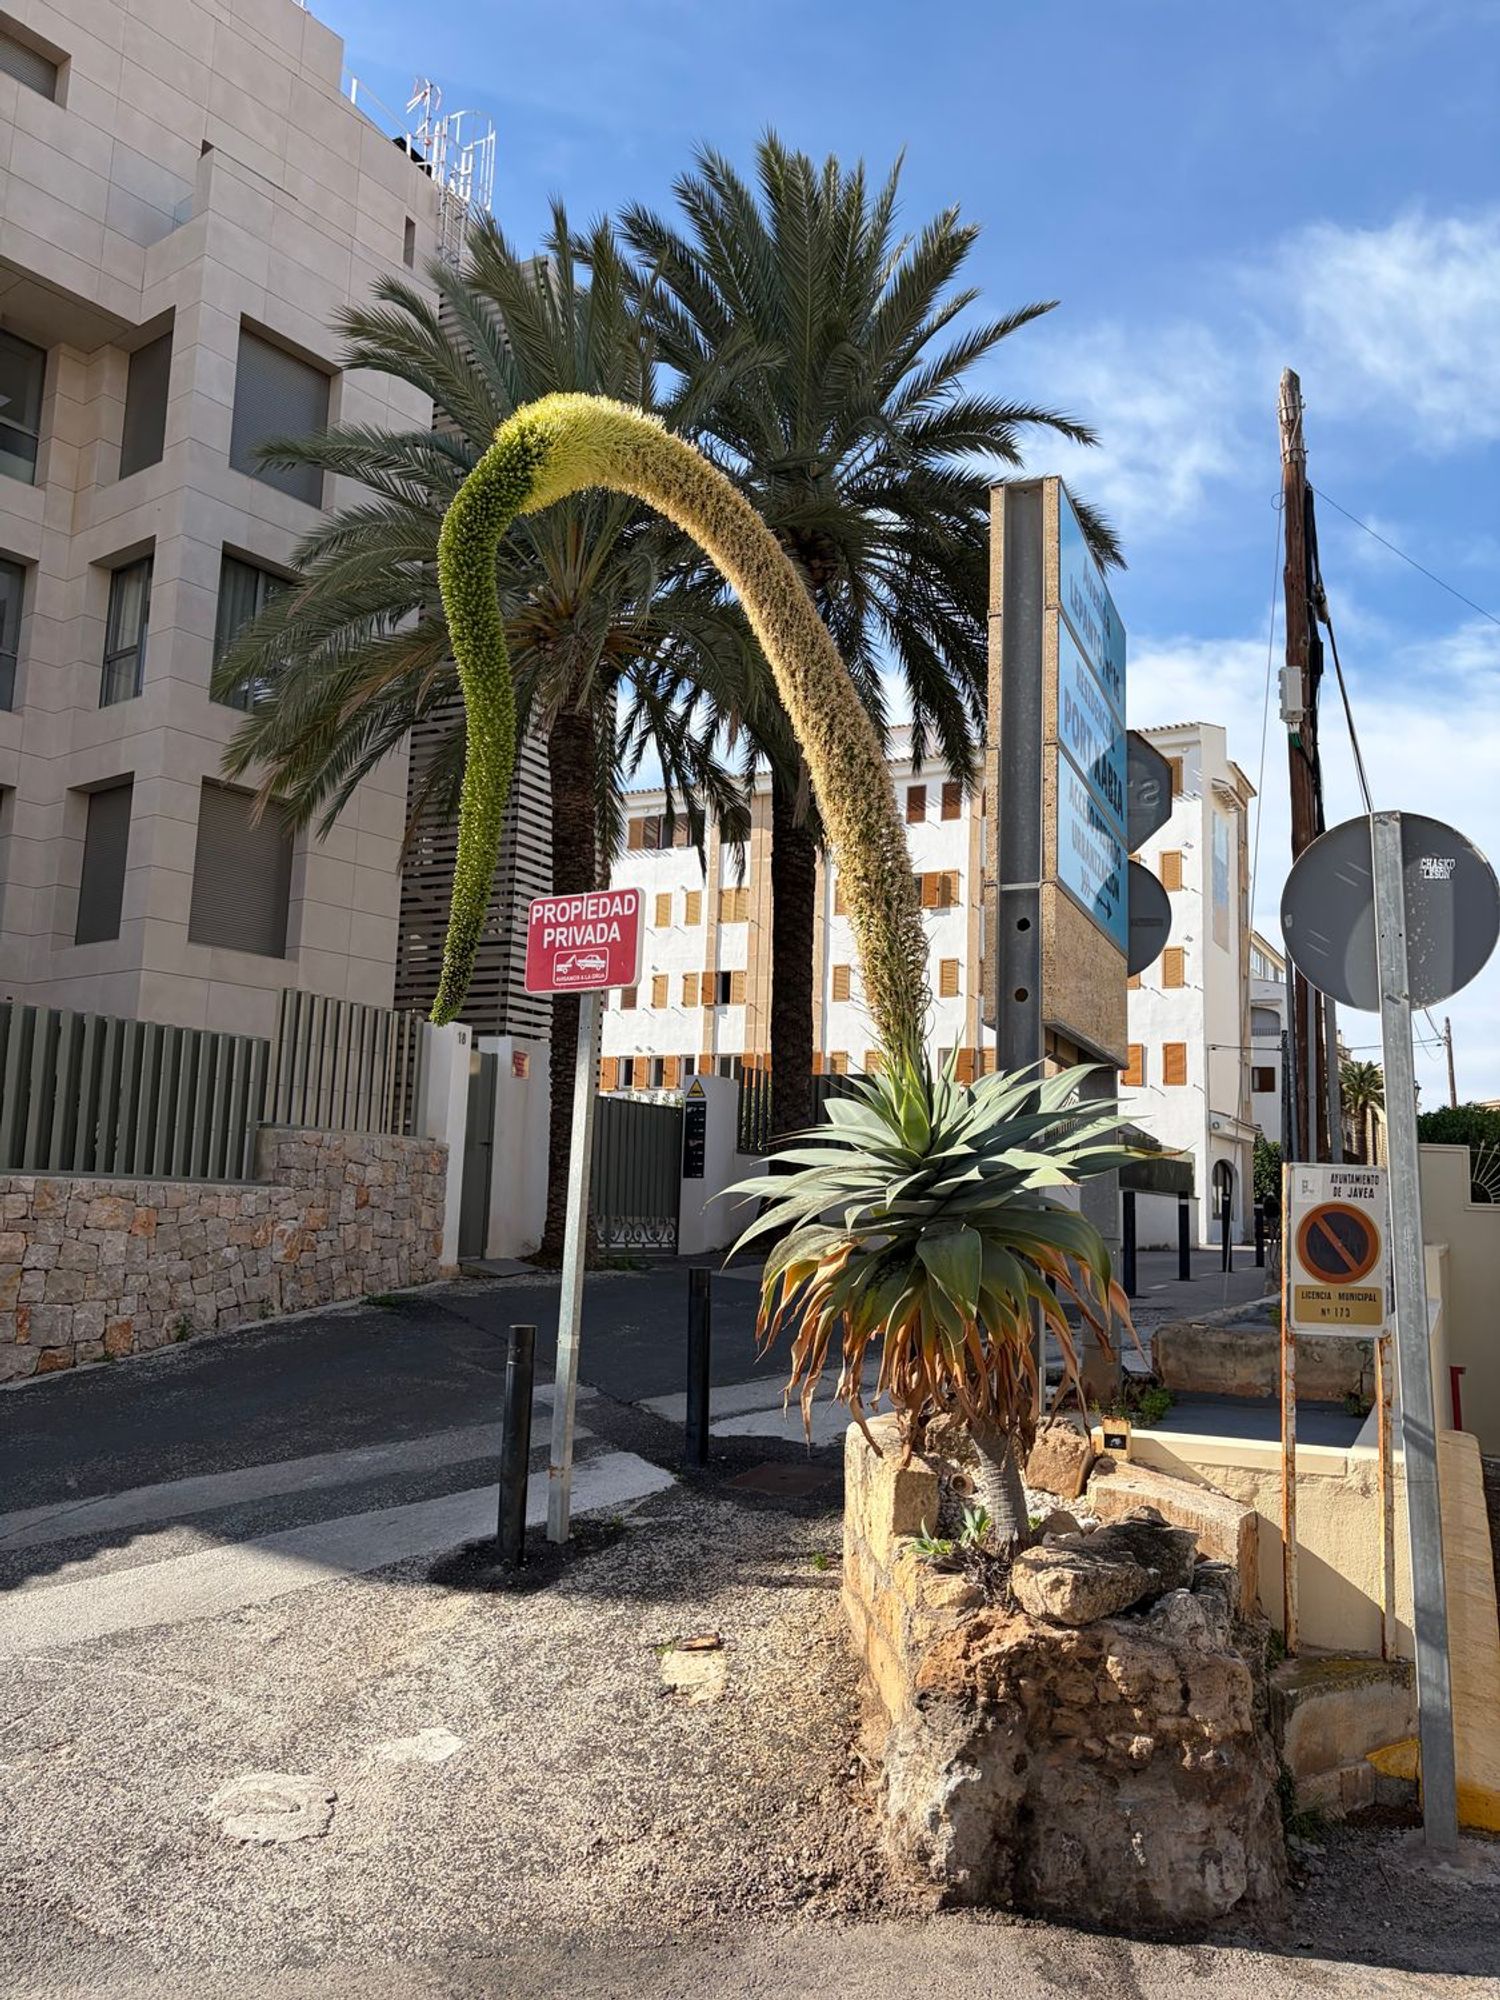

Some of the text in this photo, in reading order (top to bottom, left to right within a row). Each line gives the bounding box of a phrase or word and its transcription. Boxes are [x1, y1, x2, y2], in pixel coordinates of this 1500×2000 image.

[1064, 686, 1092, 768] PORT
[532, 894, 636, 926] PROPIEDAD
[543, 921, 621, 949] PRIVADA
[458, 1031, 467, 1045] 18
[1330, 1173, 1379, 1186] AYUNTAMIENTO
[1333, 1186, 1375, 1199] DE JAVEA
[1301, 1290, 1377, 1303] LICENCIA MUNICIPAL
